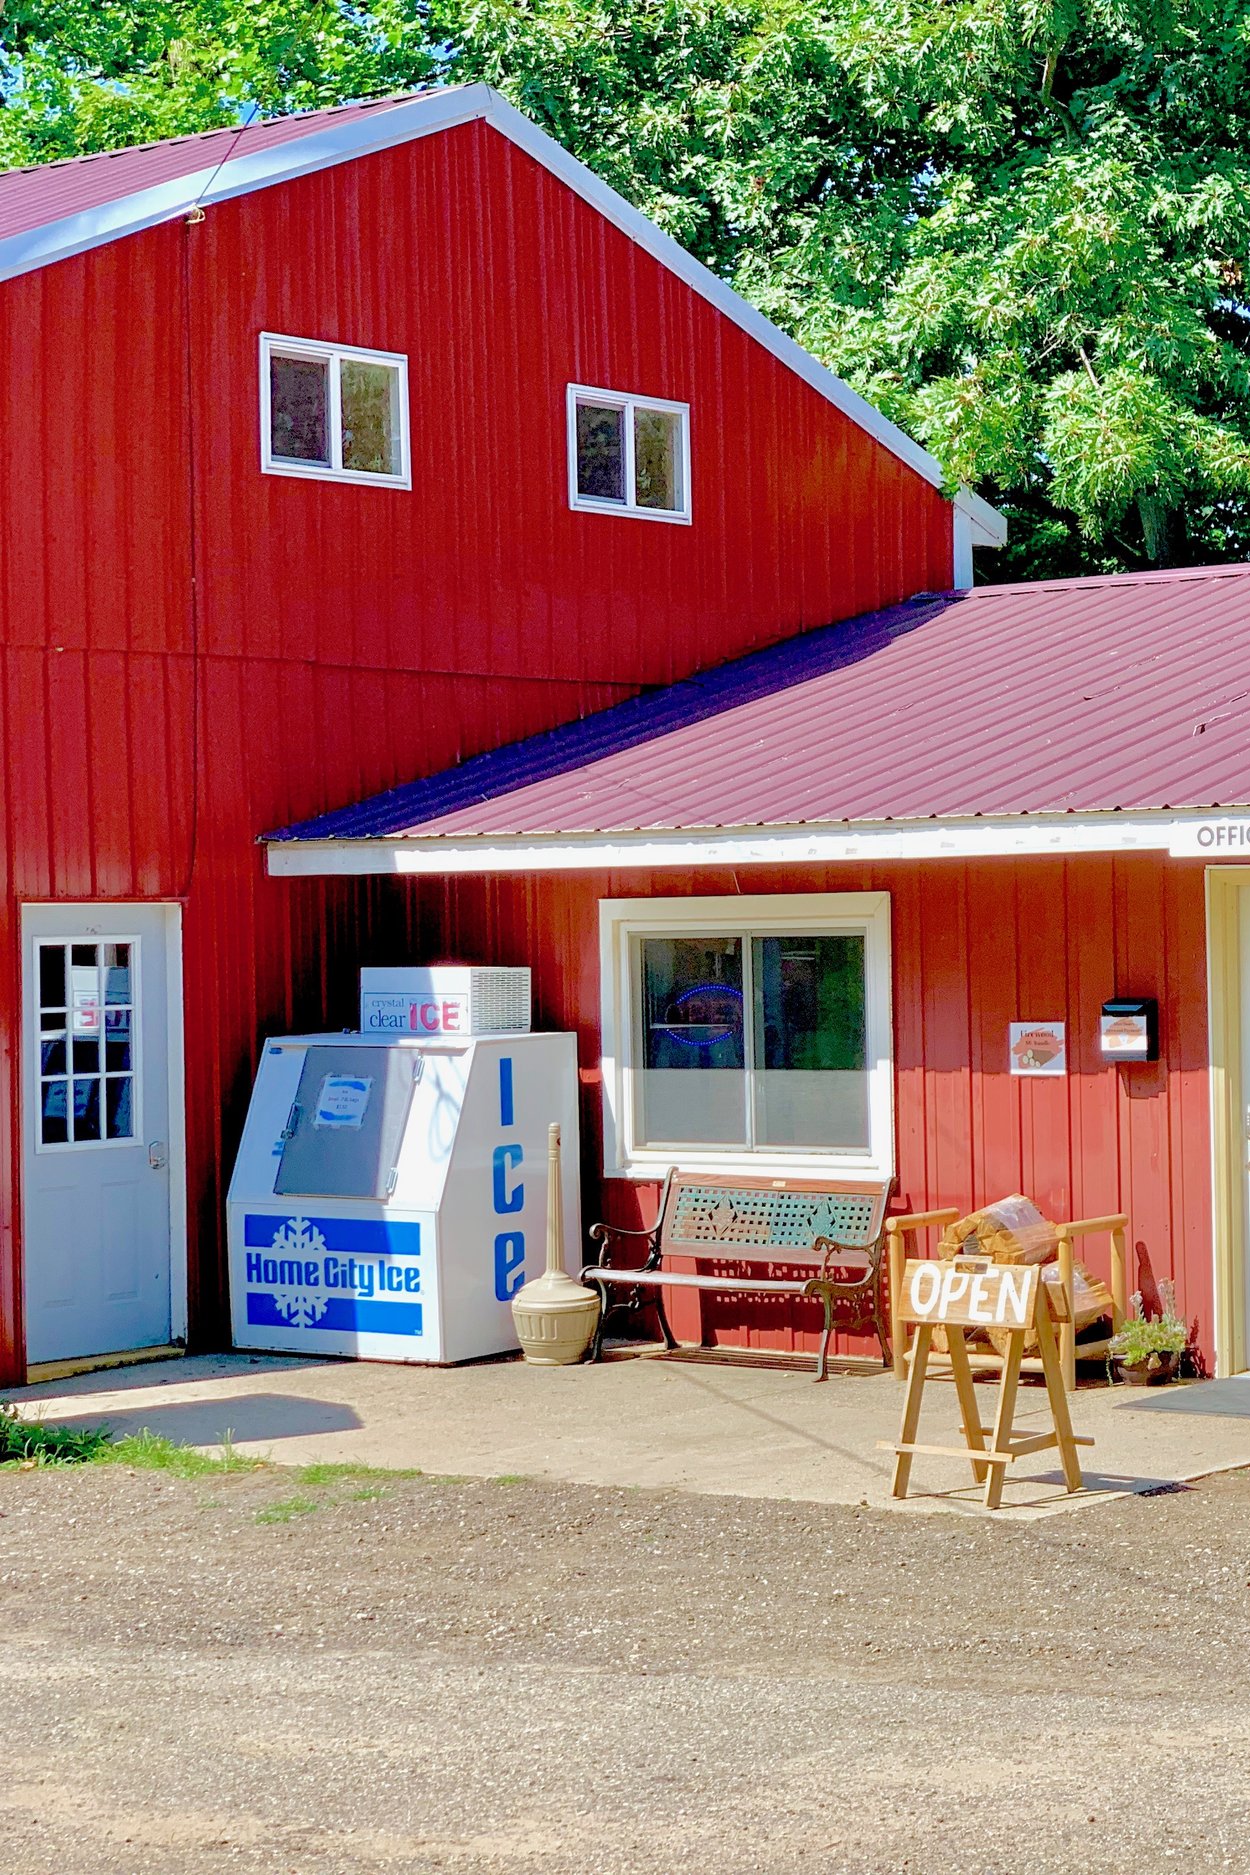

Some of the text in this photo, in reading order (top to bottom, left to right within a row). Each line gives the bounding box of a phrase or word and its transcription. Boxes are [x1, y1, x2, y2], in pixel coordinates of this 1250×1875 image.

[370, 1001, 460, 1030] clear ICE
[371, 998, 404, 1010] crystal
[246, 1252, 421, 1297] Home City Ice
[910, 1263, 1032, 1323] OPEN
